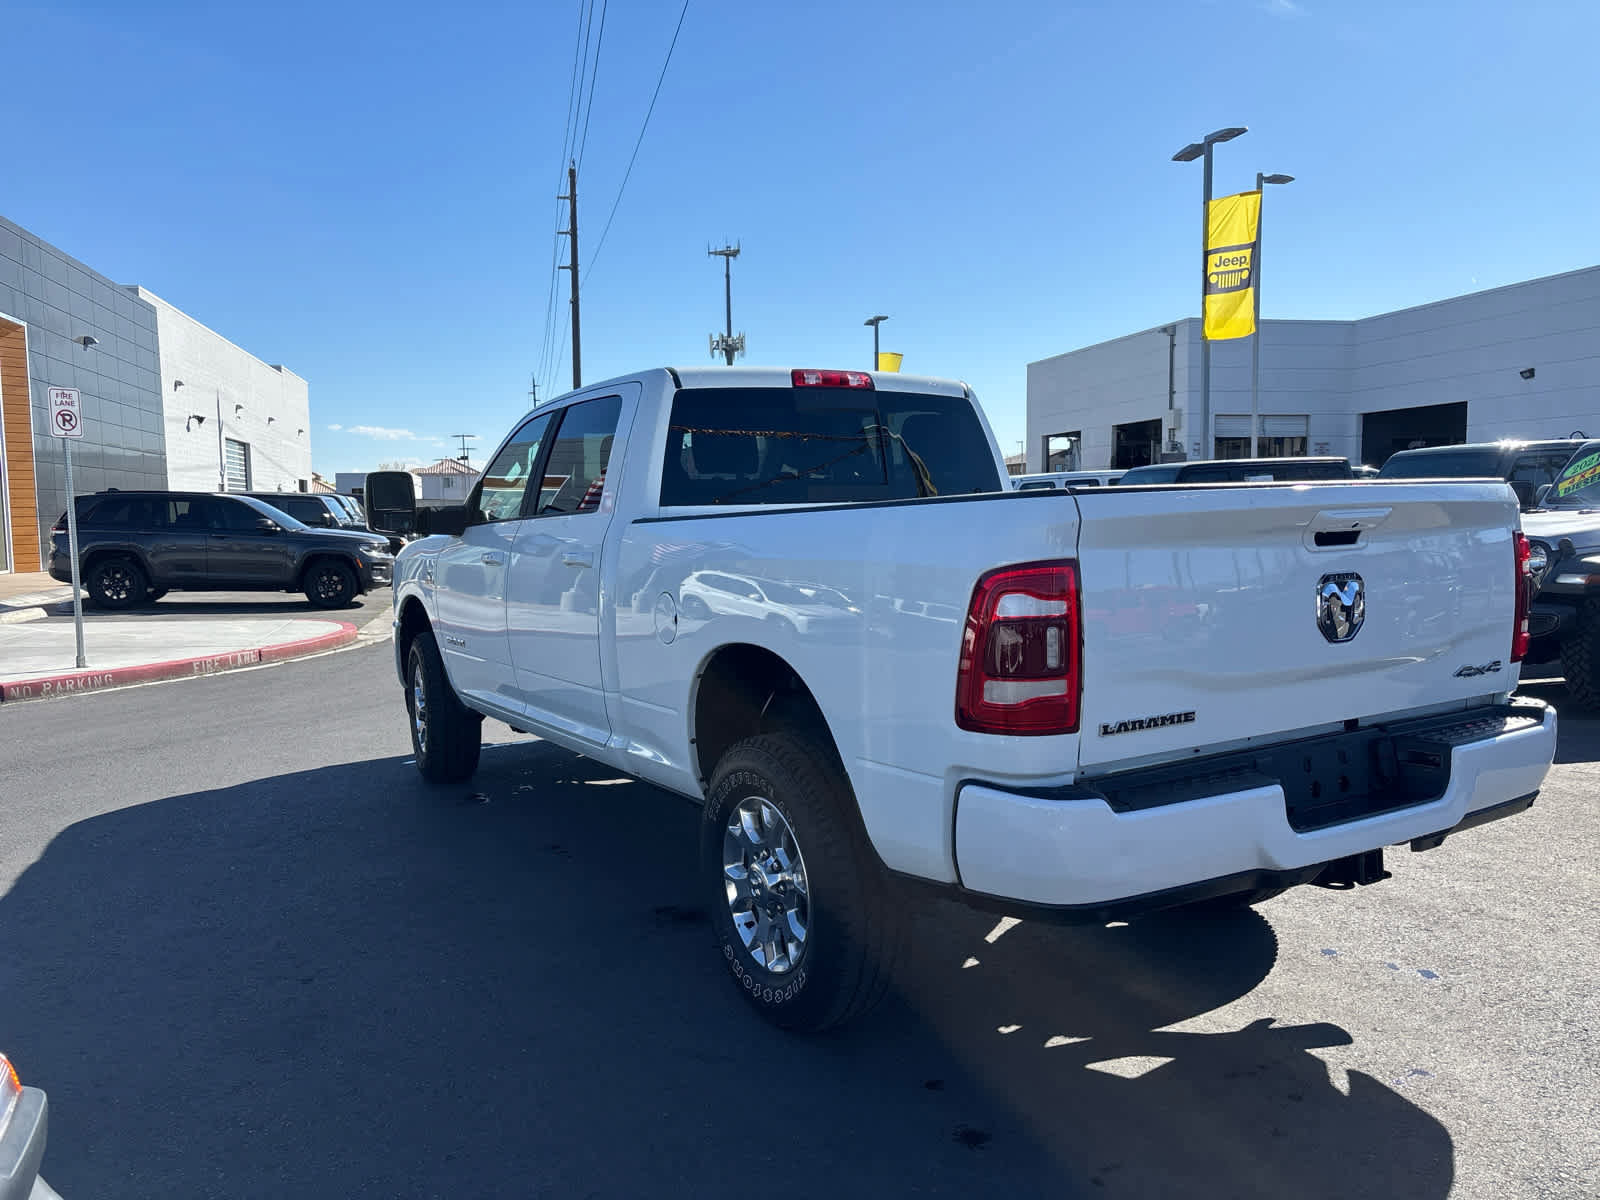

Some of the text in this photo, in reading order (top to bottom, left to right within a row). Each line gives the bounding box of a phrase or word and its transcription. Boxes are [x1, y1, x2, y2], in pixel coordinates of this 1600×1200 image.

[1214, 256, 1247, 267] Jeep
[56, 392, 73, 400] FIRE
[192, 658, 224, 674] FIRE
[10, 674, 113, 699] NO PARKING
[1098, 711, 1197, 737] LARAMIE
